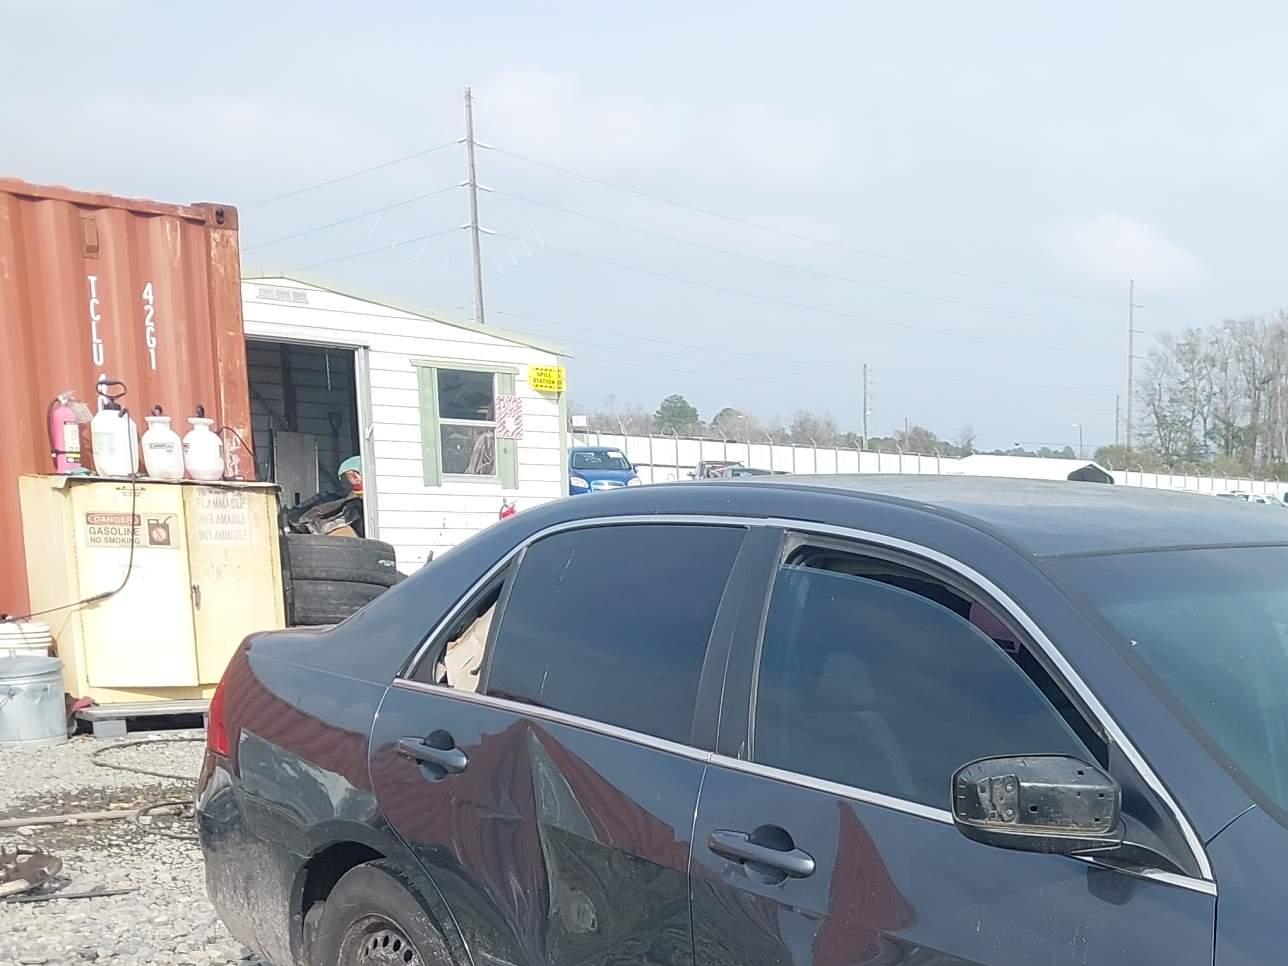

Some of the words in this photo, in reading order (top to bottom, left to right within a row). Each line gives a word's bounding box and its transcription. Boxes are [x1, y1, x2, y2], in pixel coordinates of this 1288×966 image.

[87, 275, 105, 367] TCLU
[142, 282, 157, 370] 42G1
[89, 526, 140, 536] GASOLINE
[93, 515, 133, 524] DANGER
